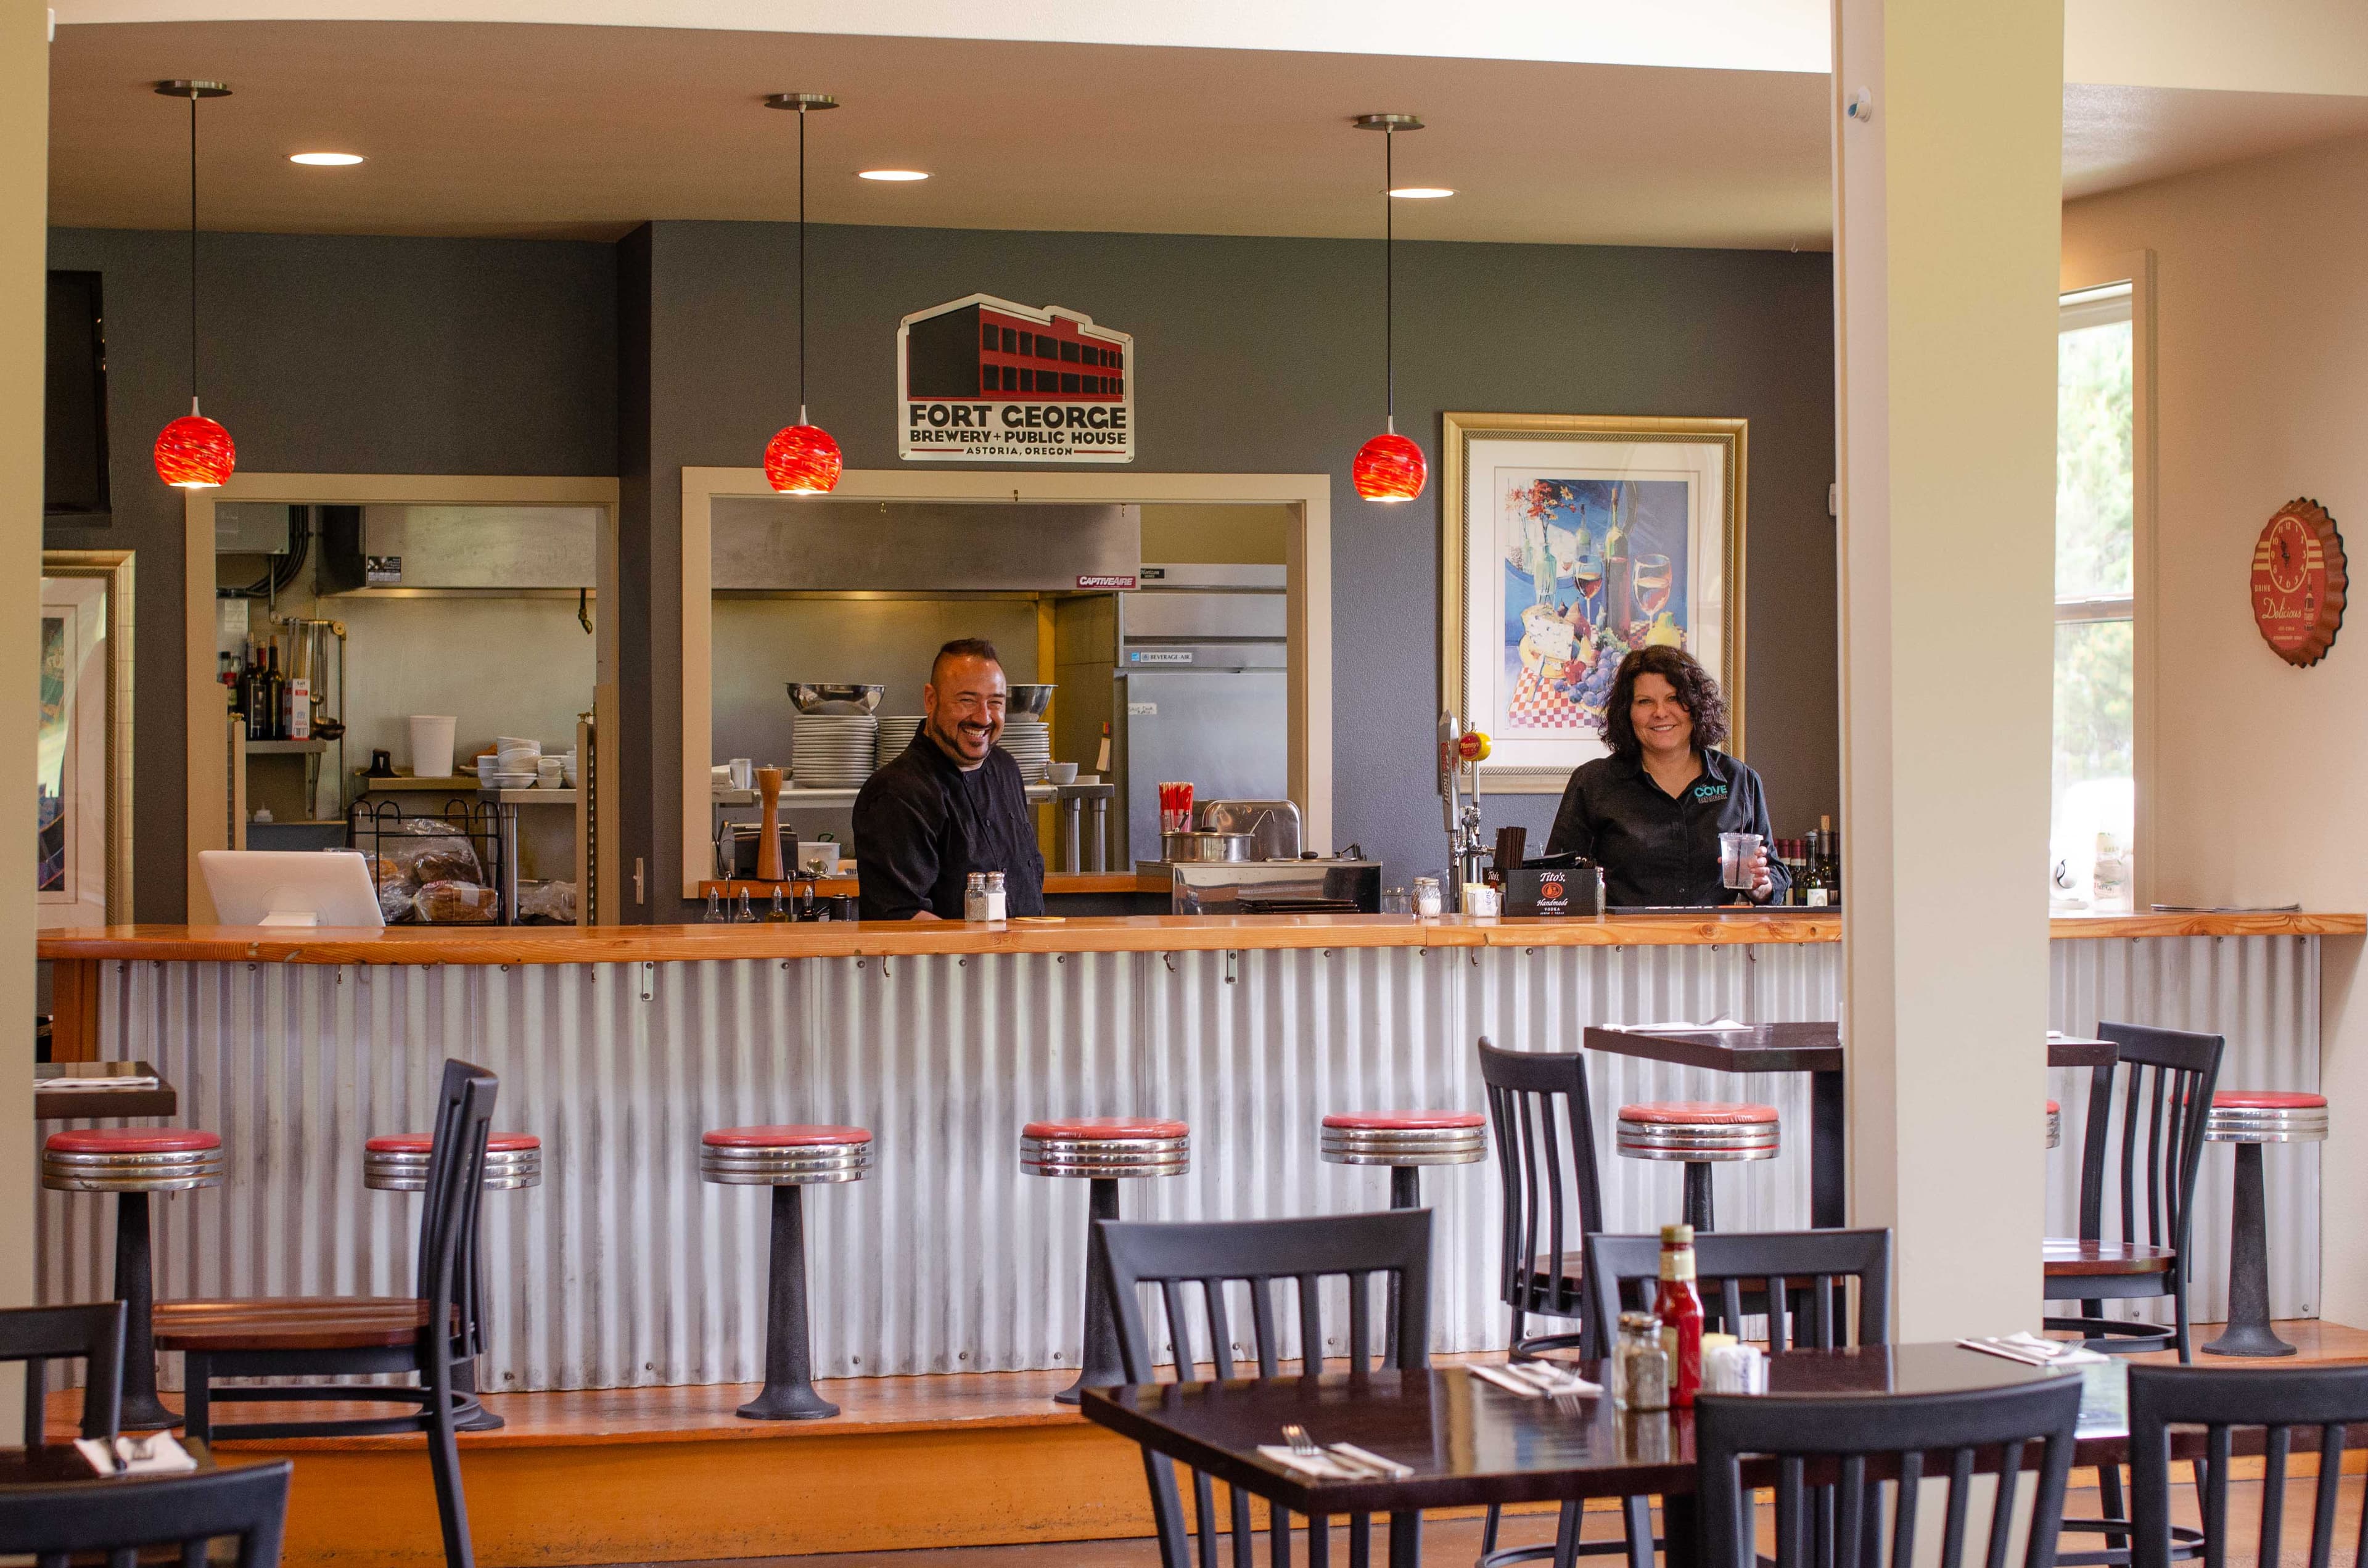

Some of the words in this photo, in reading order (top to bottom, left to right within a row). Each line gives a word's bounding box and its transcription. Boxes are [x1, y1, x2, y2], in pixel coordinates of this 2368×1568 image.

[910, 404, 992, 427] FORT
[1001, 405, 1126, 429] GEORGE
[910, 430, 992, 443] BREWERY
[1005, 430, 1065, 444] PUBLIC
[1071, 432, 1126, 445] HOUSE
[966, 446, 1022, 456] ASTORIA,
[1025, 446, 1072, 455] OREGON
[2261, 596, 2302, 619] Delicious
[1694, 784, 1728, 798] COVE
[1536, 898, 1568, 906] Handmade
